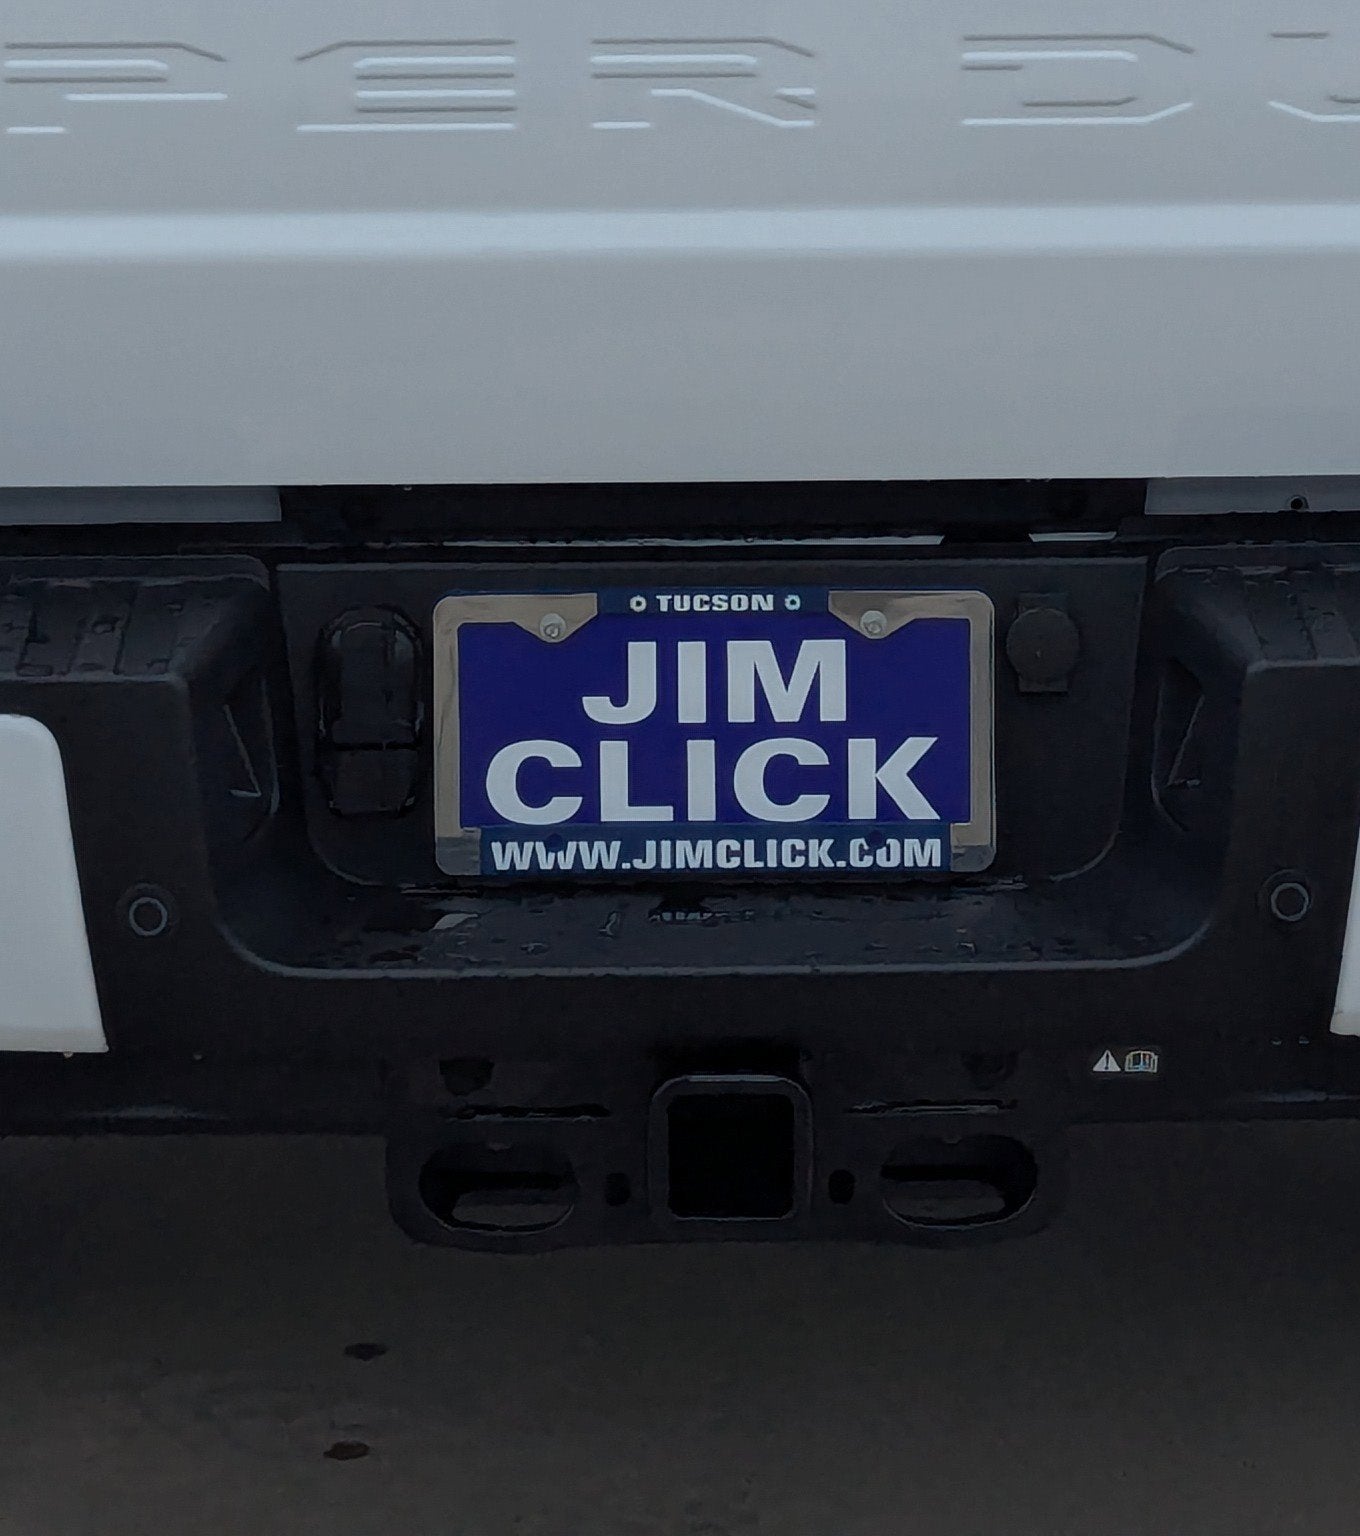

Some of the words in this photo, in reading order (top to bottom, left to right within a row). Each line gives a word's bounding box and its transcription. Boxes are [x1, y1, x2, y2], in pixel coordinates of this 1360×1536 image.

[656, 594, 774, 612] TUCSON
[581, 638, 847, 725] JIM
[485, 736, 941, 825] CLICK
[491, 837, 942, 872] WWW.JIMCLICK.COM
